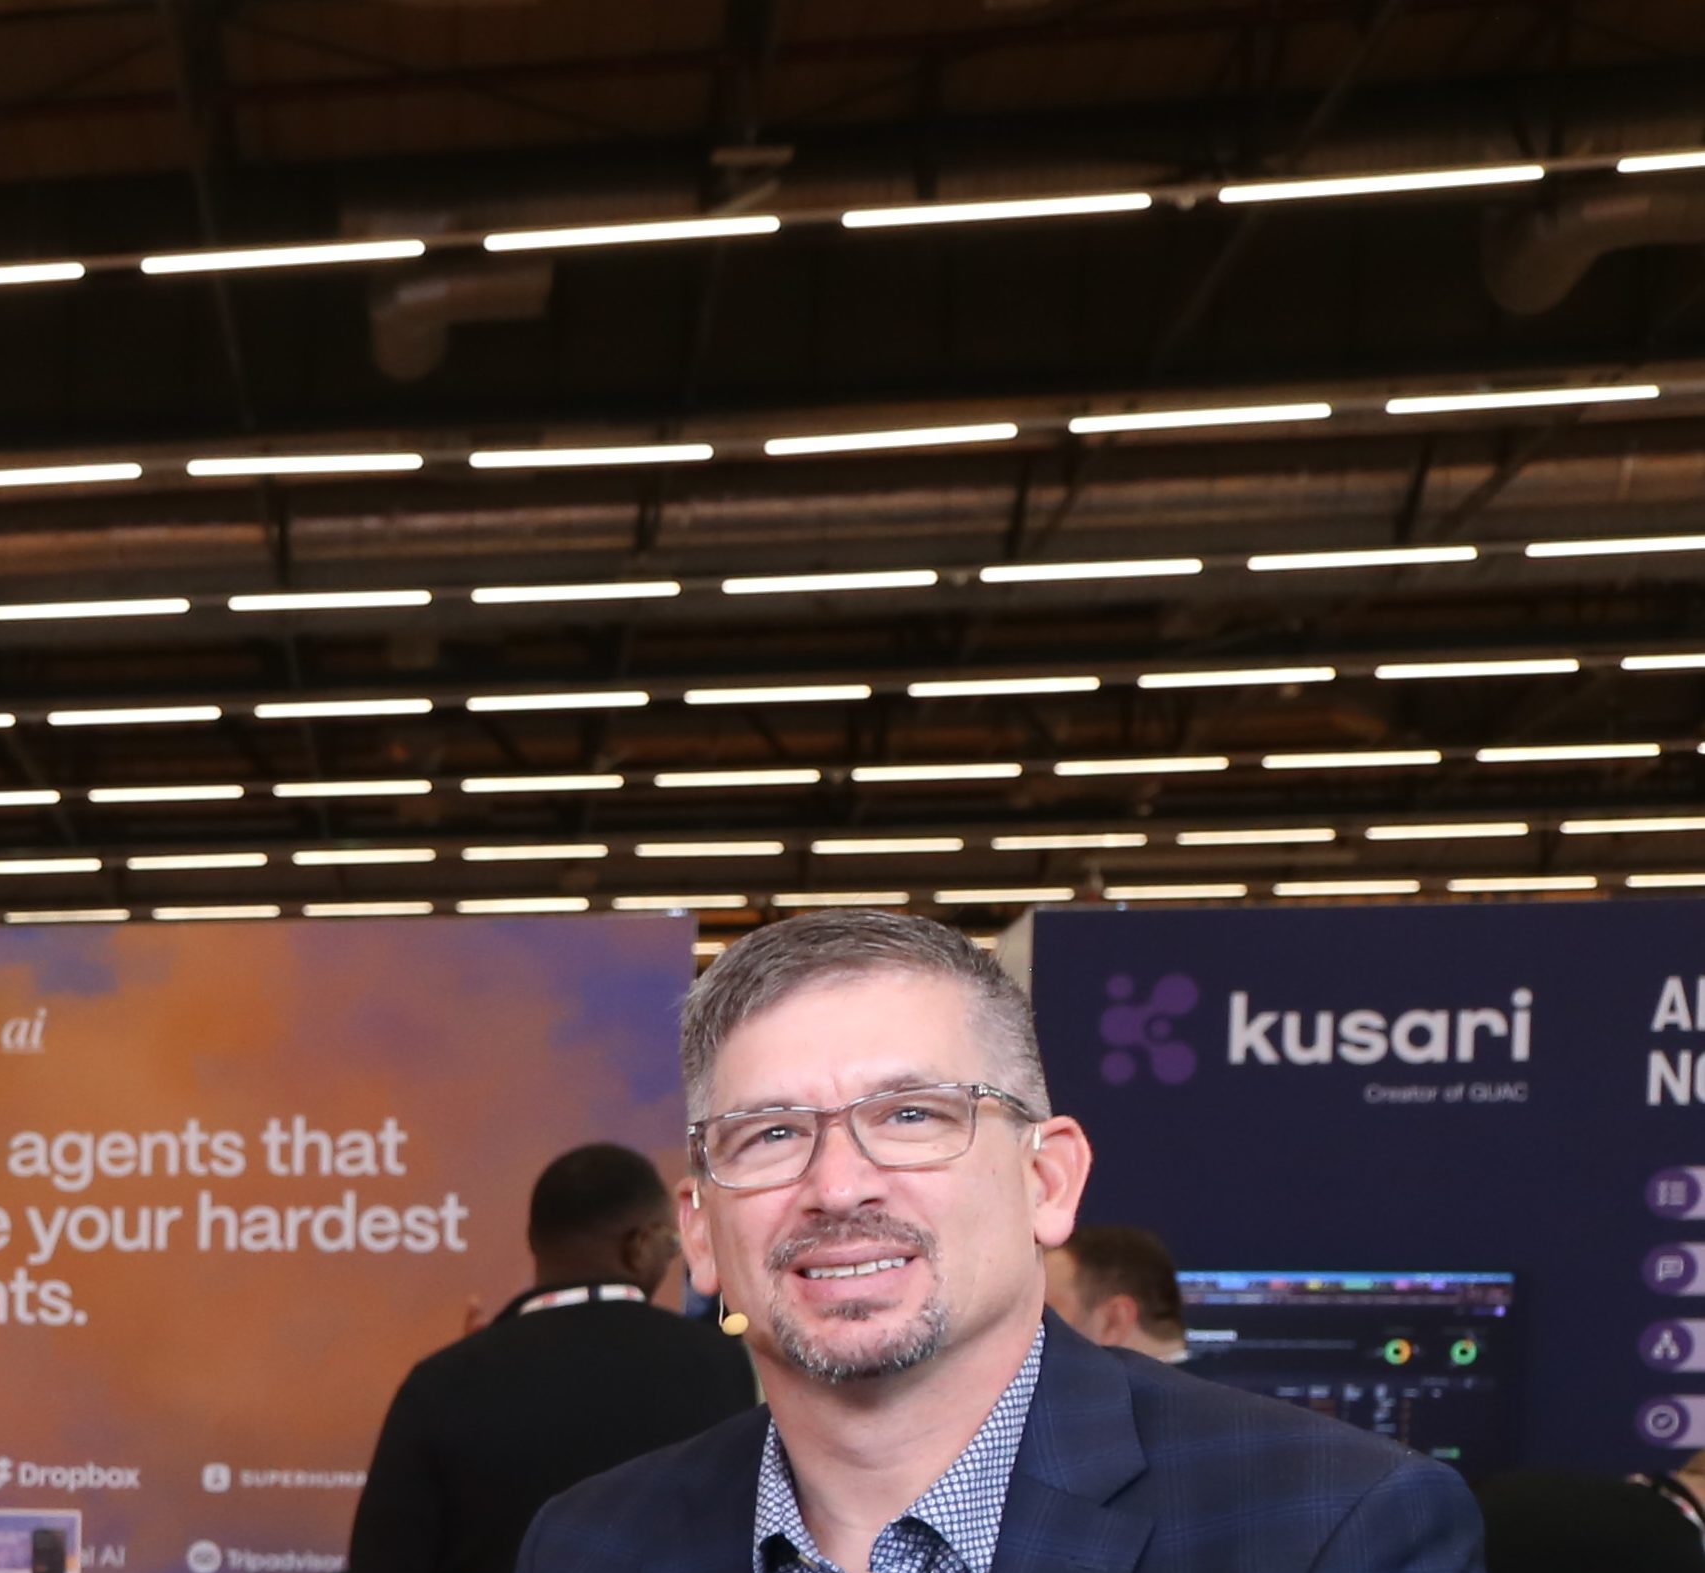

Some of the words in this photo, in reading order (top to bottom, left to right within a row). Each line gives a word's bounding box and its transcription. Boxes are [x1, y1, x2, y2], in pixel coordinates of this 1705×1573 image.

[0, 1007, 48, 1055] ai
[1227, 987, 1534, 1065] kusari
[7, 1119, 246, 1193] agents
[263, 1115, 407, 1177] that
[26, 1203, 180, 1266] your
[199, 1191, 468, 1255] hardest
[17, 1461, 142, 1494] Dropbox
[240, 1468, 369, 1488] SUPERHUMA
